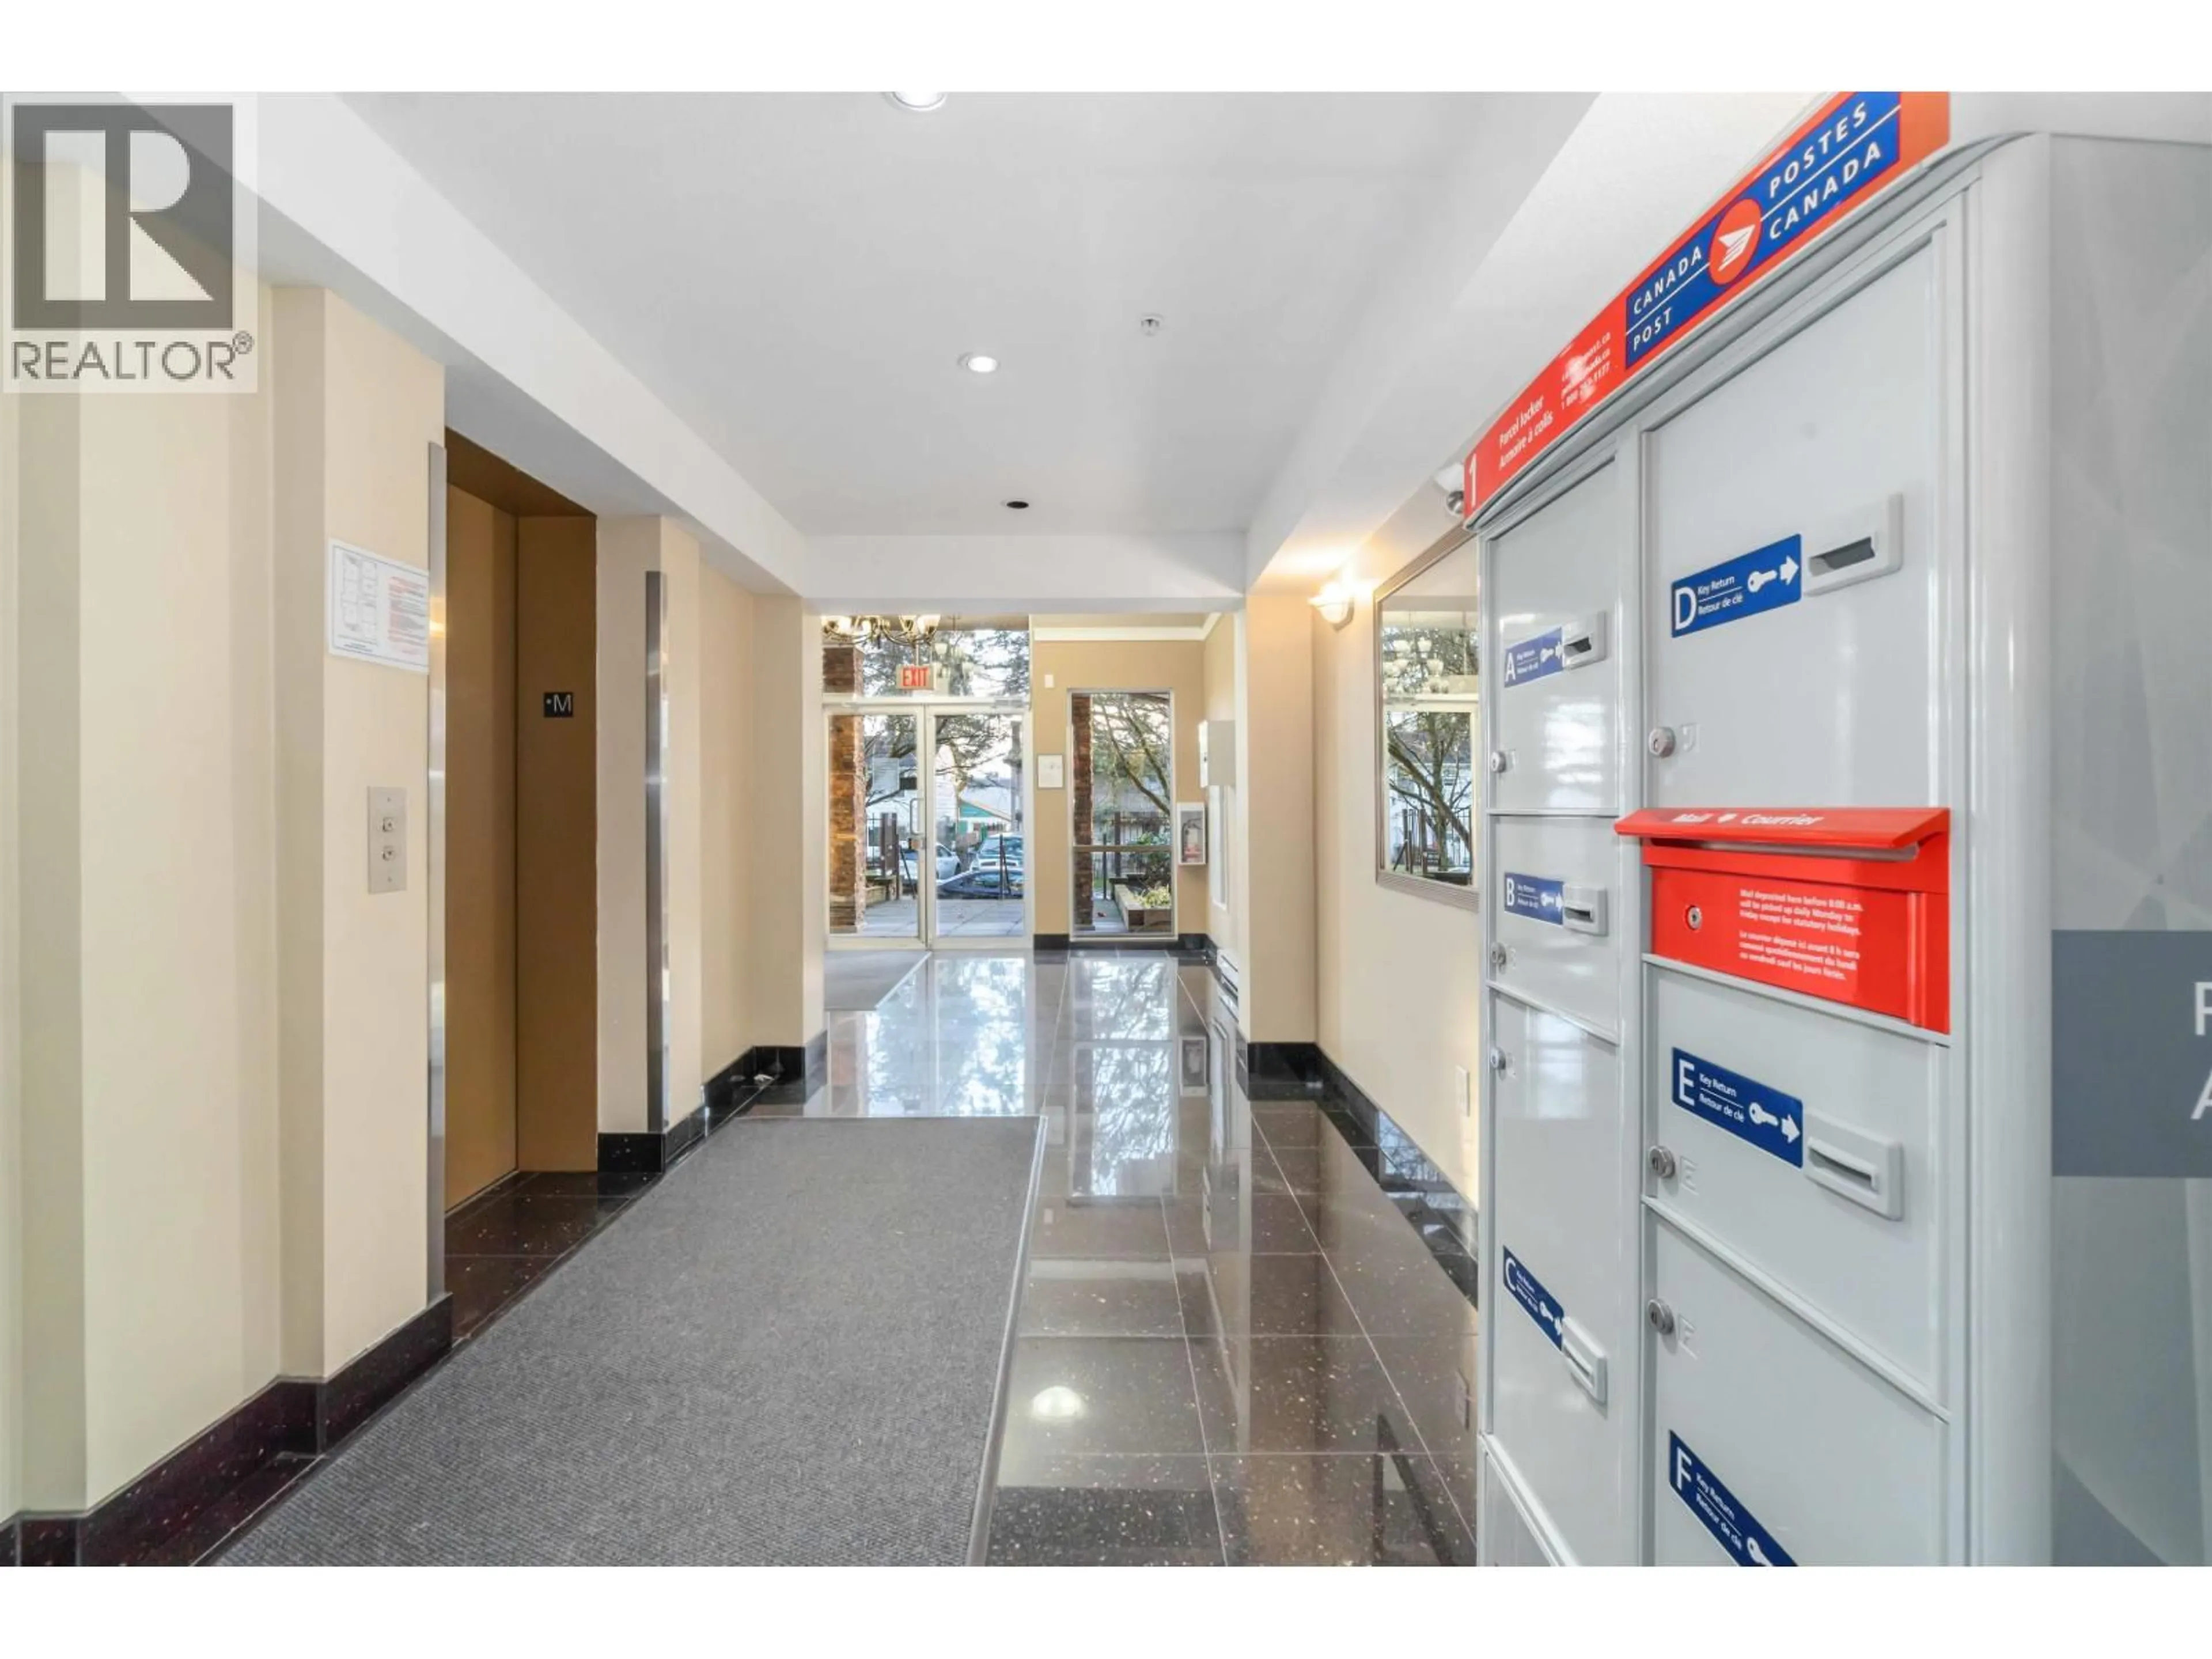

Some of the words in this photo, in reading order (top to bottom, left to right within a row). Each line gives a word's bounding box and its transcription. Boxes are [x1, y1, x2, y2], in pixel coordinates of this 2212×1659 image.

[1770, 101, 1866, 198] POSTES
[1770, 142, 1881, 239] CANADA
[1634, 247, 1702, 315] CANADA
[1634, 307, 1672, 352] POST
[1500, 416, 1519, 449] Parcel
[1521, 394, 1544, 427] locker
[1499, 437, 1527, 471] Armoire
[1535, 410, 1554, 436] colis
[1469, 453, 1477, 507] 1
[1698, 585, 1710, 596] Key
[1711, 576, 1735, 590] Return
[1675, 586, 1696, 630] D
[1698, 602, 1720, 615] Retour
[1722, 597, 1731, 607] de
[1732, 592, 1744, 604] clé
[903, 667, 929, 686] EXIT
[1505, 652, 1516, 683] A
[1741, 813, 1825, 825] Courrier
[1507, 877, 1514, 906] B
[1812, 909, 1842, 921] Monday
[1679, 1059, 1695, 1106] E
[1699, 1073, 1711, 1088] Key
[1713, 1078, 1737, 1097] Return
[1699, 1093, 1722, 1112] Retour
[1724, 1105, 1733, 1117] de
[1505, 1257, 1516, 1291] C
[1677, 1446, 1692, 1491] F
[1710, 1487, 1735, 1521] Return
